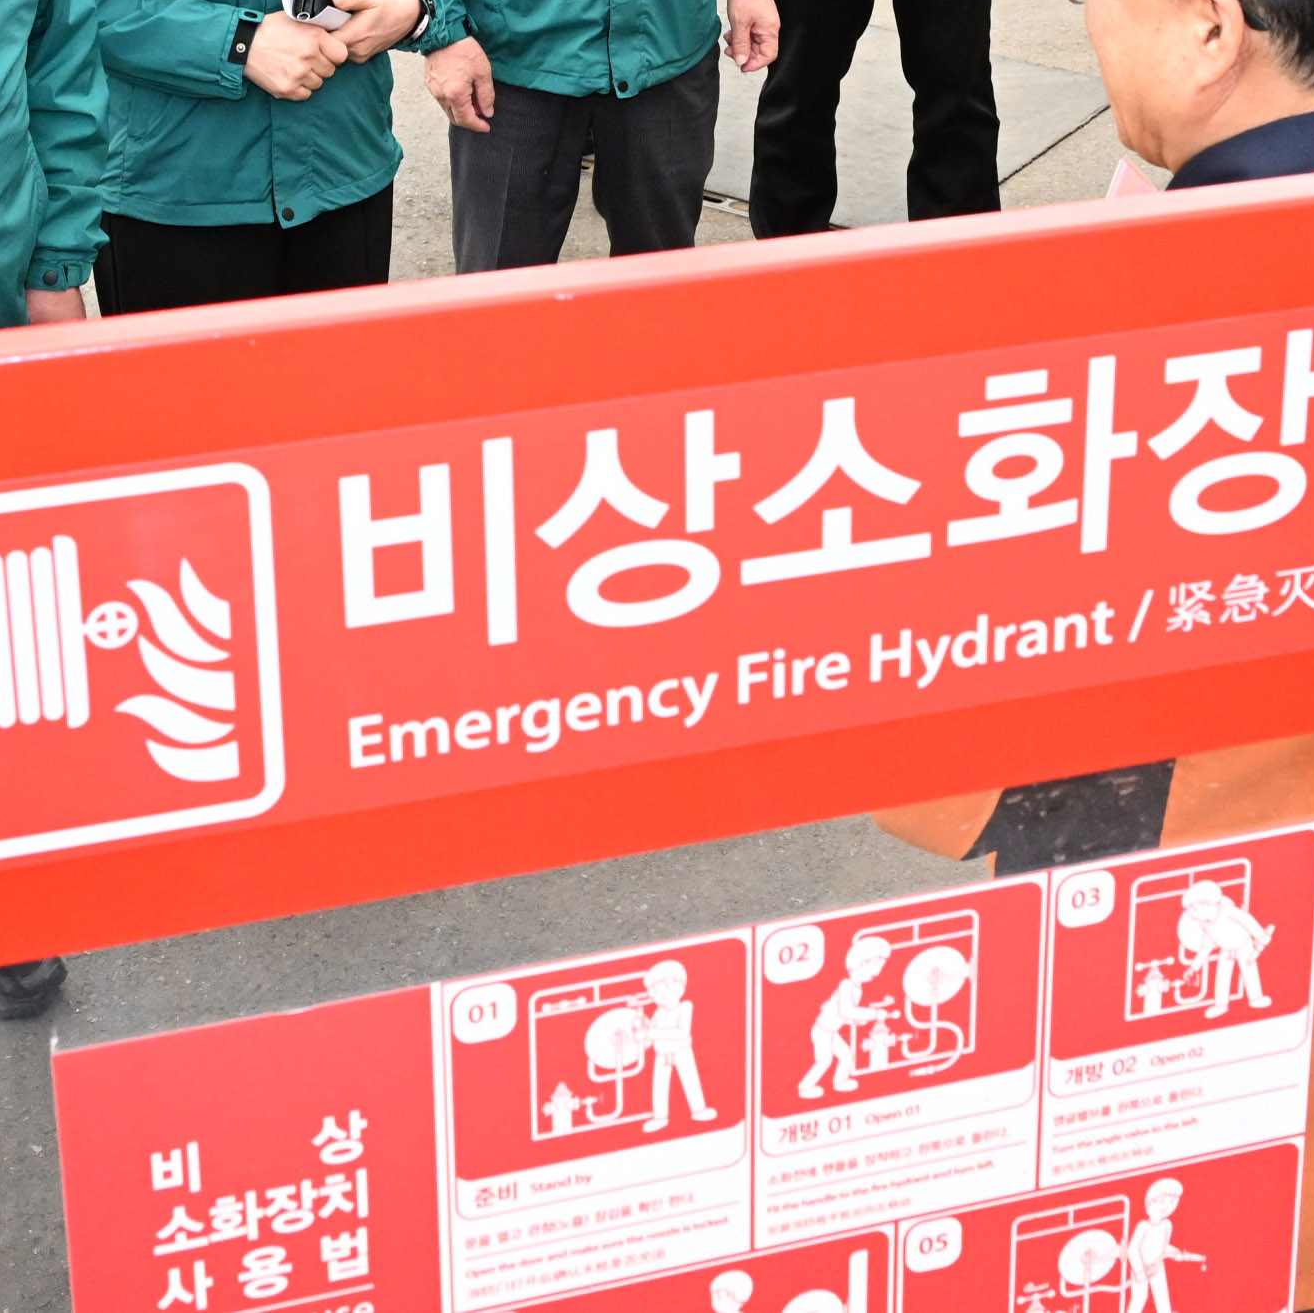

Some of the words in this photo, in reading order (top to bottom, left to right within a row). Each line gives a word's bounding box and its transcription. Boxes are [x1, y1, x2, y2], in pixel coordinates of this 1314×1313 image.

[348, 673, 719, 768] Emergency
[737, 647, 851, 705] Fire
[869, 602, 1115, 689] Hydrant
[1071, 888, 1101, 910] 03
[778, 941, 811, 967] 02
[467, 999, 499, 1027] 01
[1065, 1061, 1104, 1086] 개방
[1112, 1056, 1137, 1076] 02
[1150, 1050, 1185, 1068] Open
[1188, 1046, 1204, 1059] 02
[778, 1120, 820, 1144] 개방
[828, 1115, 853, 1135] 01
[865, 1107, 903, 1126] Open
[905, 1104, 922, 1117] 01
[1077, 1139, 1093, 1150] the
[1164, 1121, 1180, 1131] the
[474, 1181, 518, 1209] 준비
[530, 1174, 572, 1194] Stand
[574, 1171, 593, 1187] by
[638, 1197, 665, 1214] 확인
[782, 1200, 799, 1211] the
[853, 1186, 870, 1197] the
[932, 1169, 952, 1181] and
[153, 1166, 370, 1259] 소화장치
[465, 1264, 496, 1280] Open
[498, 1259, 516, 1273] the
[519, 1254, 543, 1268] door
[547, 1249, 567, 1263] and
[569, 1243, 599, 1258] make
[602, 1238, 624, 1250] sure
[626, 1233, 644, 1246] the
[645, 1225, 679, 1241] nozzle
[918, 1232, 950, 1256] 05
